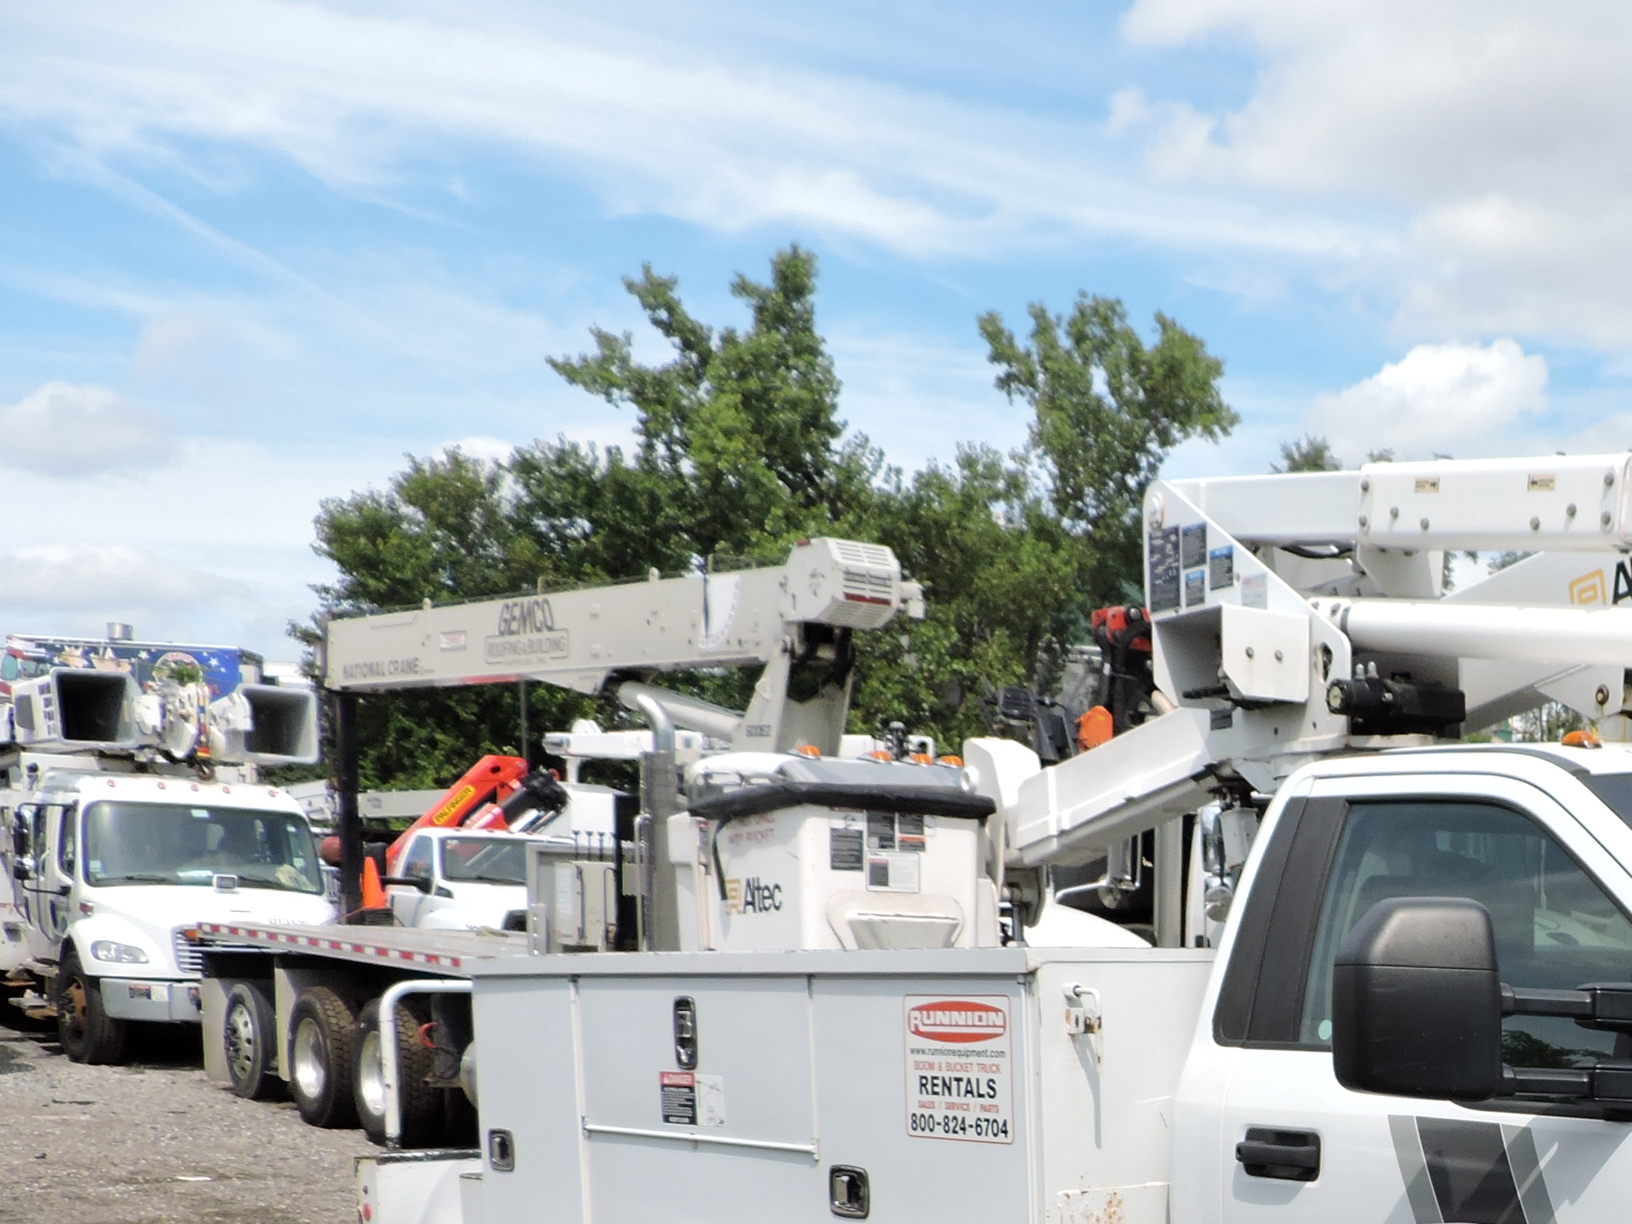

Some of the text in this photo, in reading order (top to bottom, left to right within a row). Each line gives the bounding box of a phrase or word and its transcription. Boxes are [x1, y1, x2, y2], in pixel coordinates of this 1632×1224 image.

[498, 598, 554, 636] GEMCO
[343, 657, 419, 679] NATIONAL CRANE
[743, 877, 782, 914] Altec
[909, 1010, 1005, 1034] RUNNION
[914, 1060, 935, 1071] BOOM
[945, 1062, 973, 1073] BUCKET
[976, 1063, 1001, 1074] TRUCK
[919, 1075, 997, 1099] RENTALS
[910, 1113, 1009, 1138] 800-824-6704
